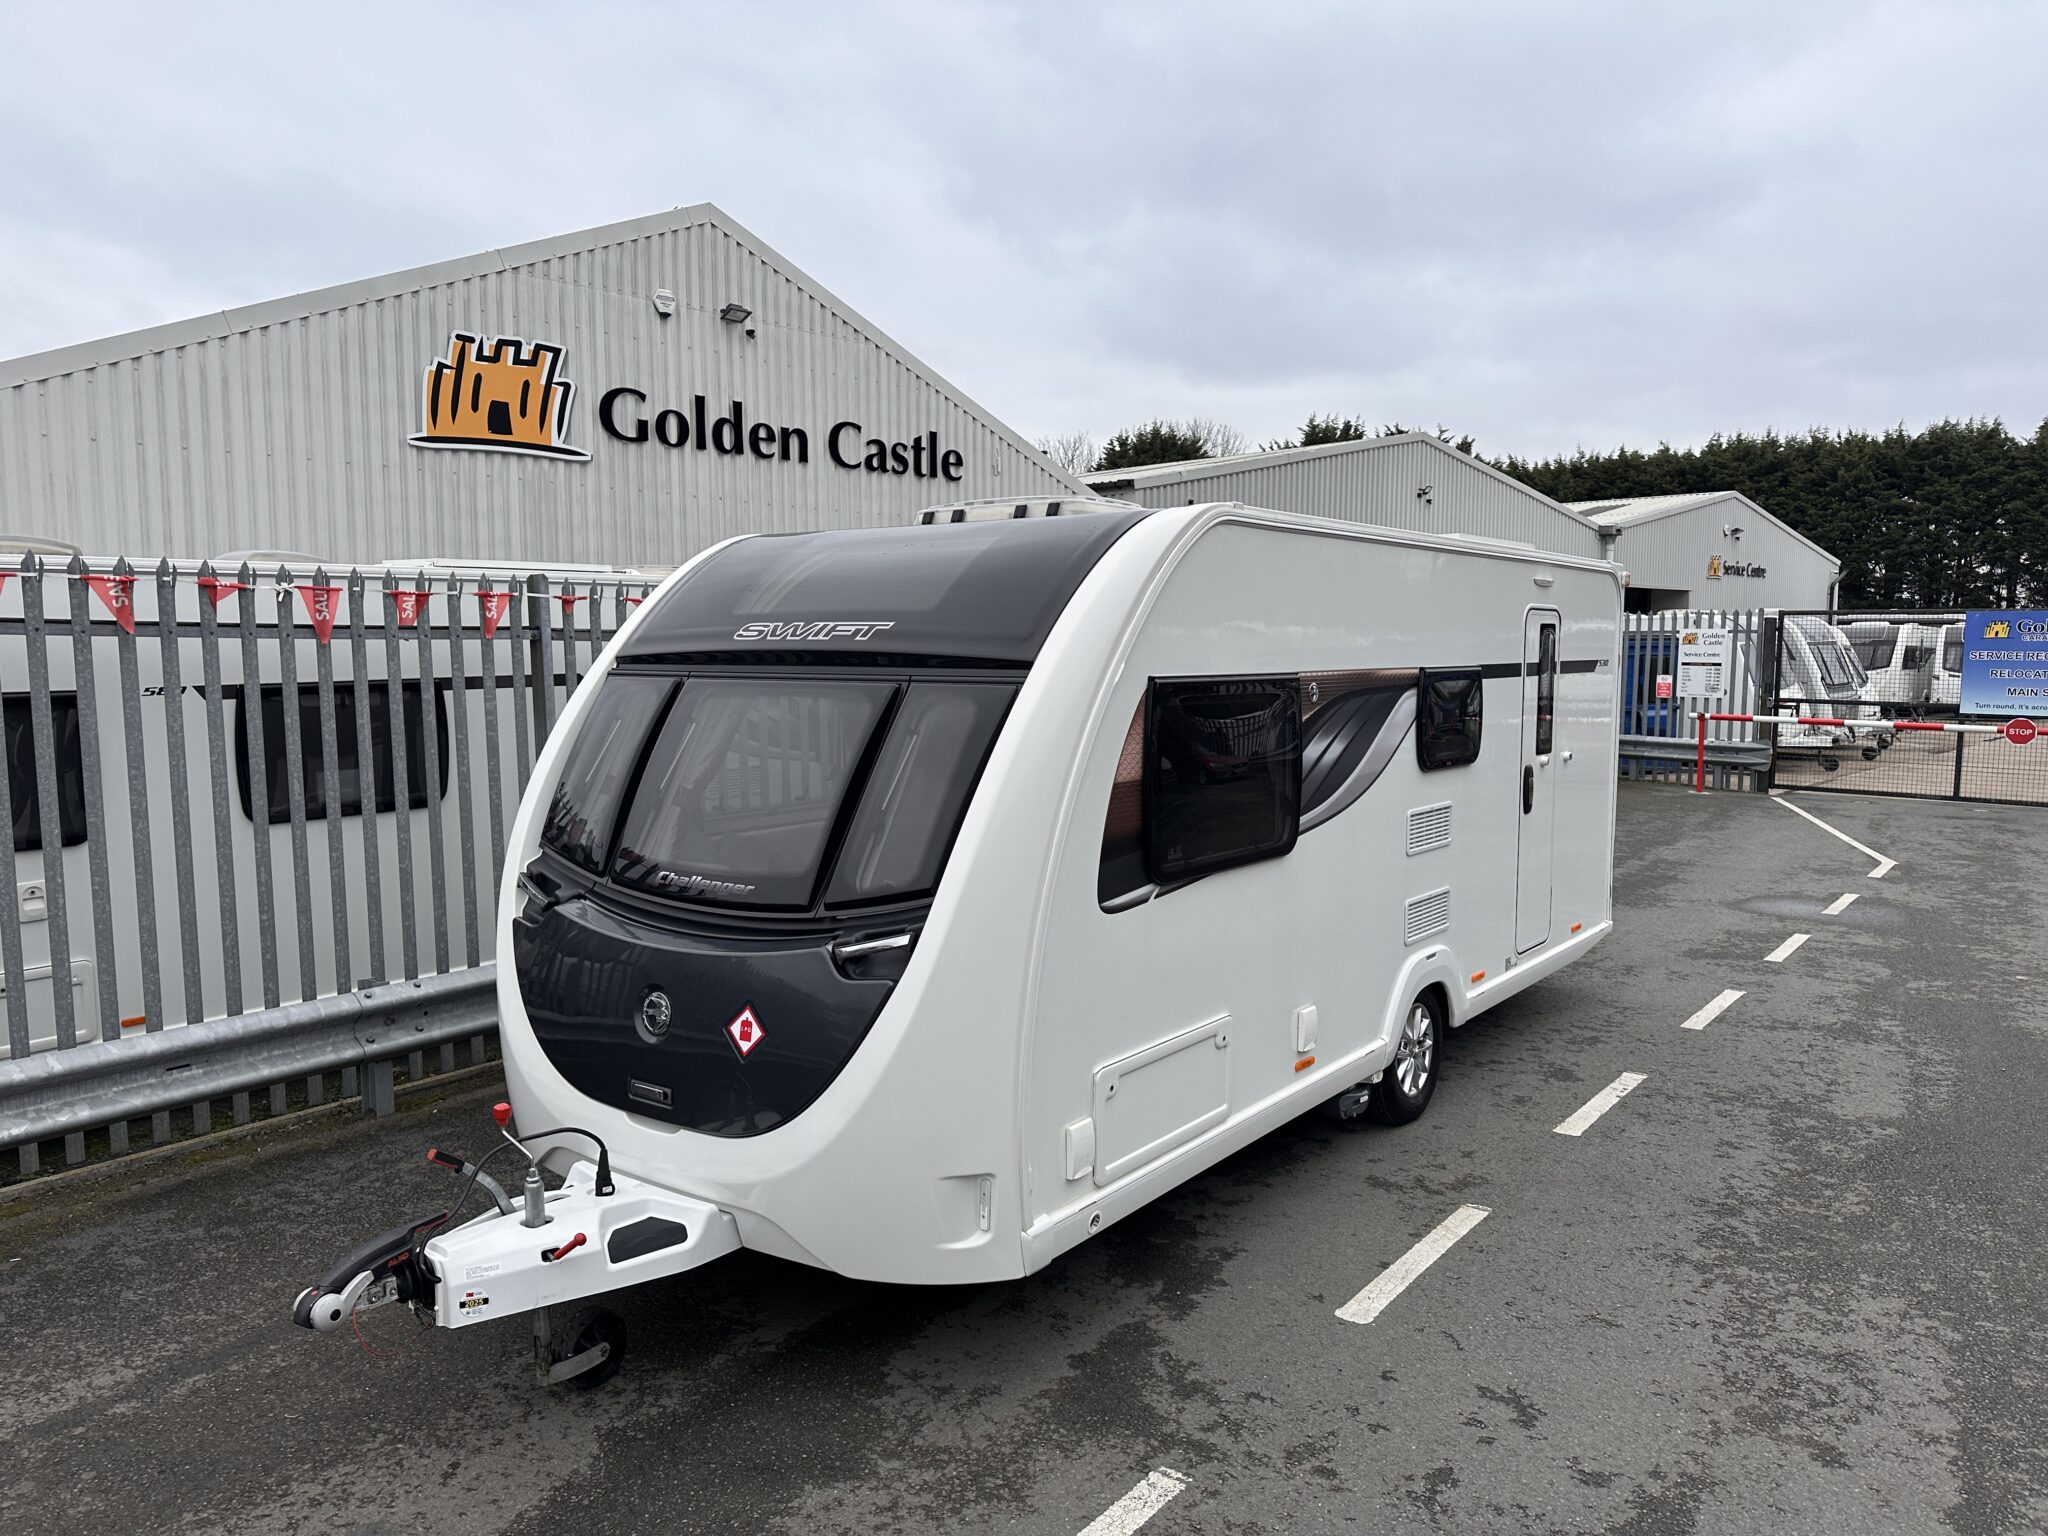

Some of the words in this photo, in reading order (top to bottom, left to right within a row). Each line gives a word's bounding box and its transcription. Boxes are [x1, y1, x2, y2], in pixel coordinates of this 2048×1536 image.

[599, 387, 808, 463] Golden
[828, 420, 964, 482] Castle
[1723, 560, 1745, 577] Service
[1747, 562, 1767, 578] Centre
[733, 622, 896, 640] SWIFT
[1970, 651, 2023, 660] SERVICE
[1990, 669, 2048, 679] RELOCAT
[2007, 688, 2039, 697] MAIN
[656, 871, 756, 895] Challenger
[465, 1299, 484, 1308] 2025
